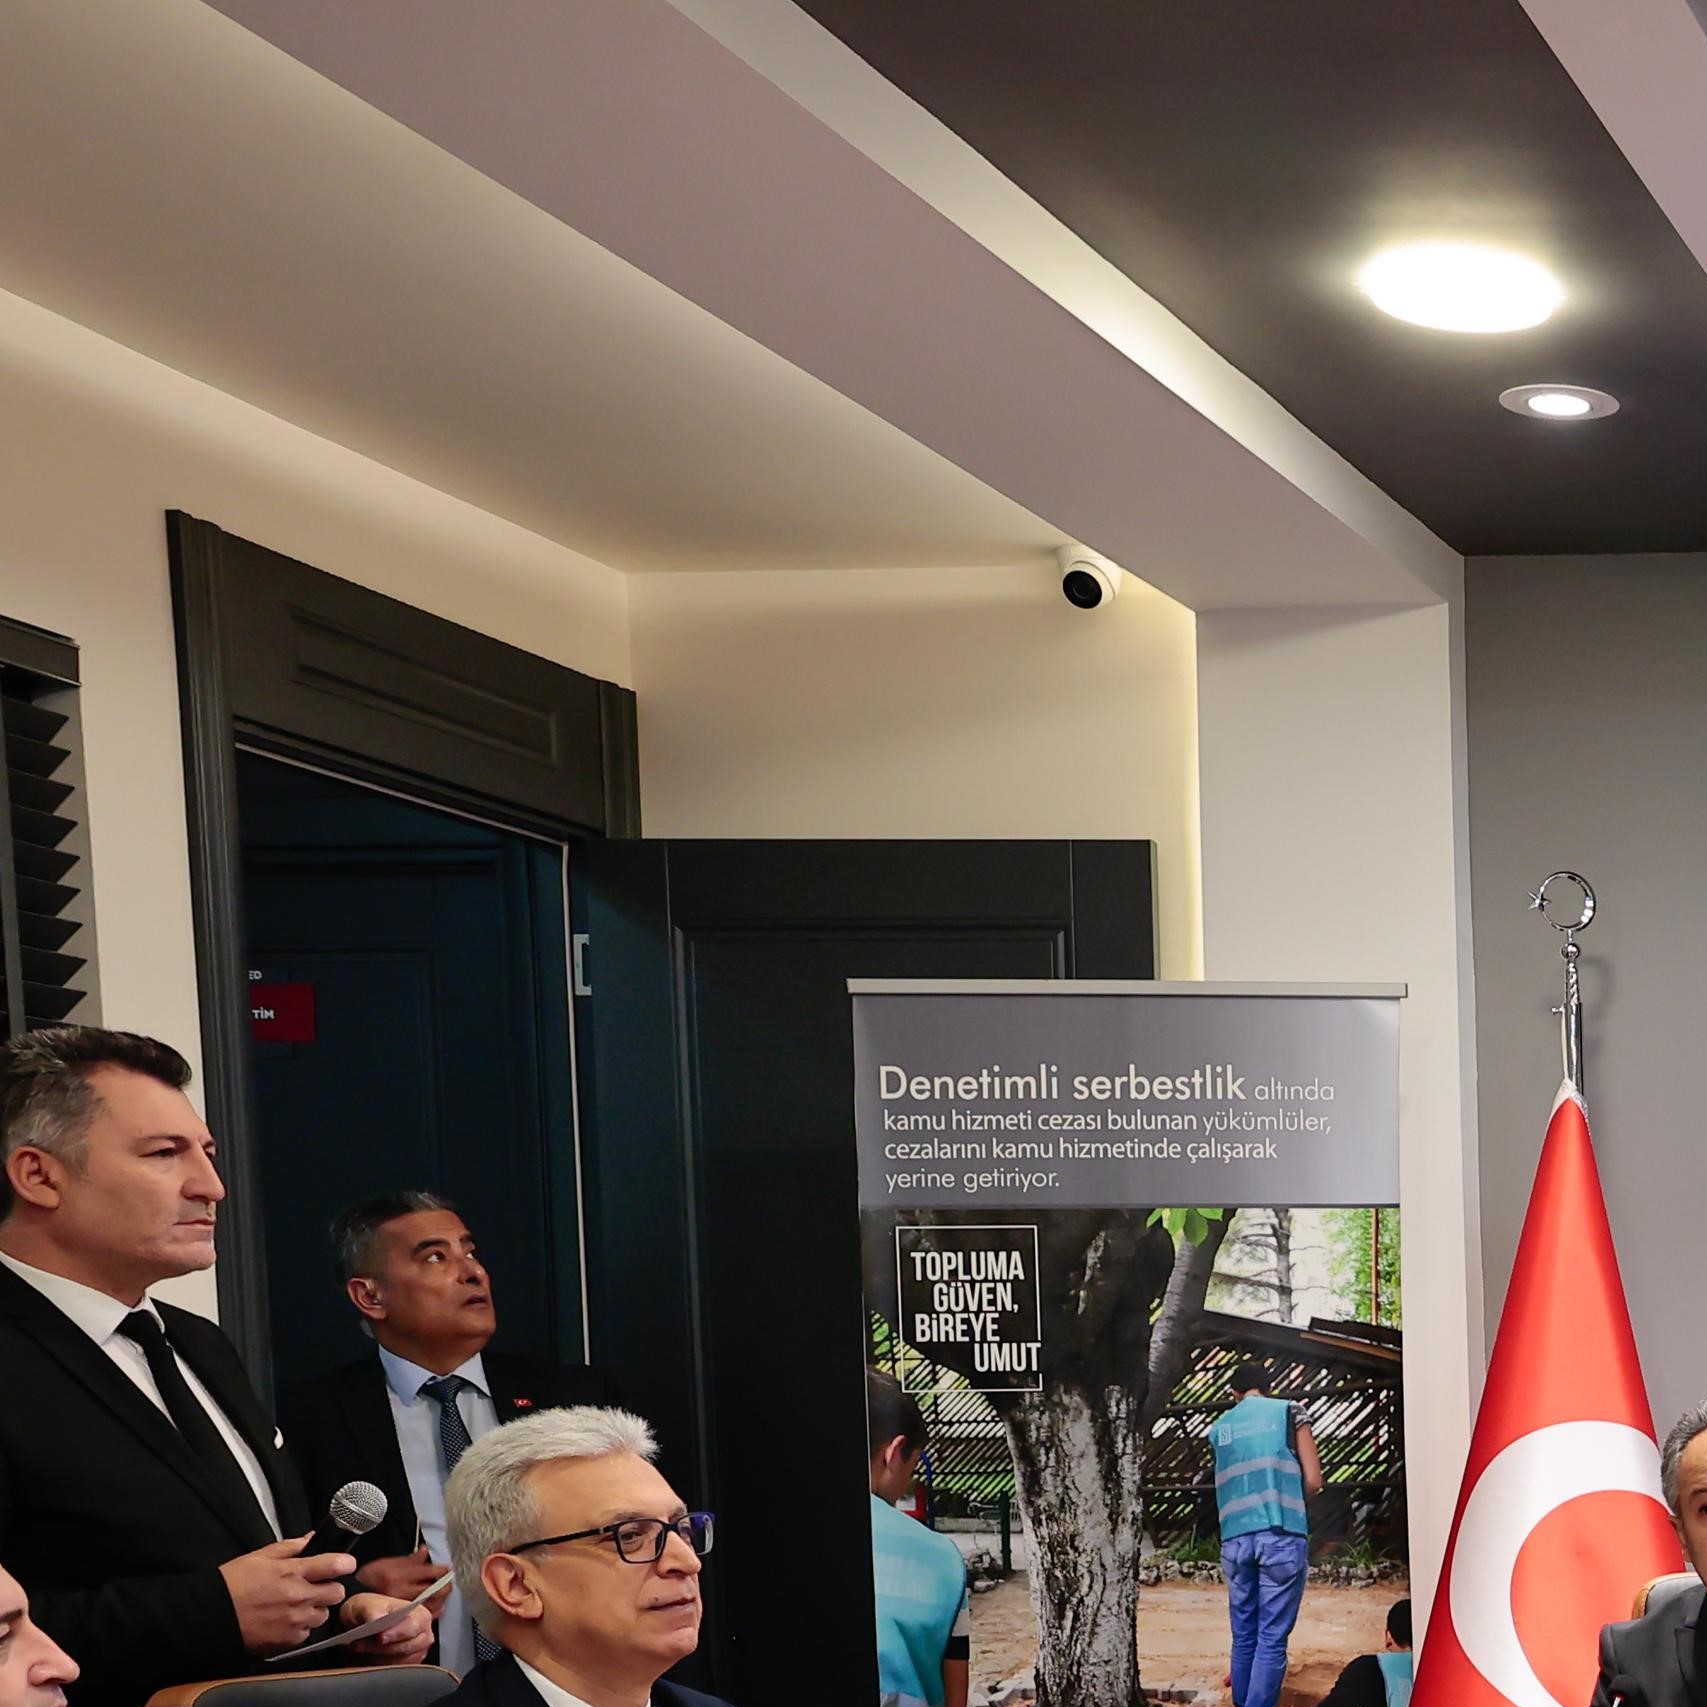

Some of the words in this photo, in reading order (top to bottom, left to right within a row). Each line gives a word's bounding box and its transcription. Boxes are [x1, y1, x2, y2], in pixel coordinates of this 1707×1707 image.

[878, 1064, 1060, 1101] Denetimli
[1072, 1064, 1247, 1102] serbestlik
[1254, 1076, 1335, 1102] altında
[883, 1109, 947, 1131] kamu
[951, 1108, 1032, 1131] hizmeti
[1037, 1113, 1103, 1132] cezası
[1107, 1109, 1198, 1132] bulunan
[1202, 1109, 1332, 1138] yükümlüler,
[884, 1137, 987, 1160] cezalarını
[992, 1137, 1053, 1159] kamu
[1059, 1137, 1181, 1160] hizmetinde
[1186, 1137, 1278, 1165] çalışarak
[884, 1168, 956, 1193] yerine
[963, 1167, 1061, 1193] getiriyor.
[910, 1250, 1025, 1282] TOPLUMA
[933, 1282, 1019, 1314] GÜVEN,
[973, 1342, 1041, 1373] UMUT
